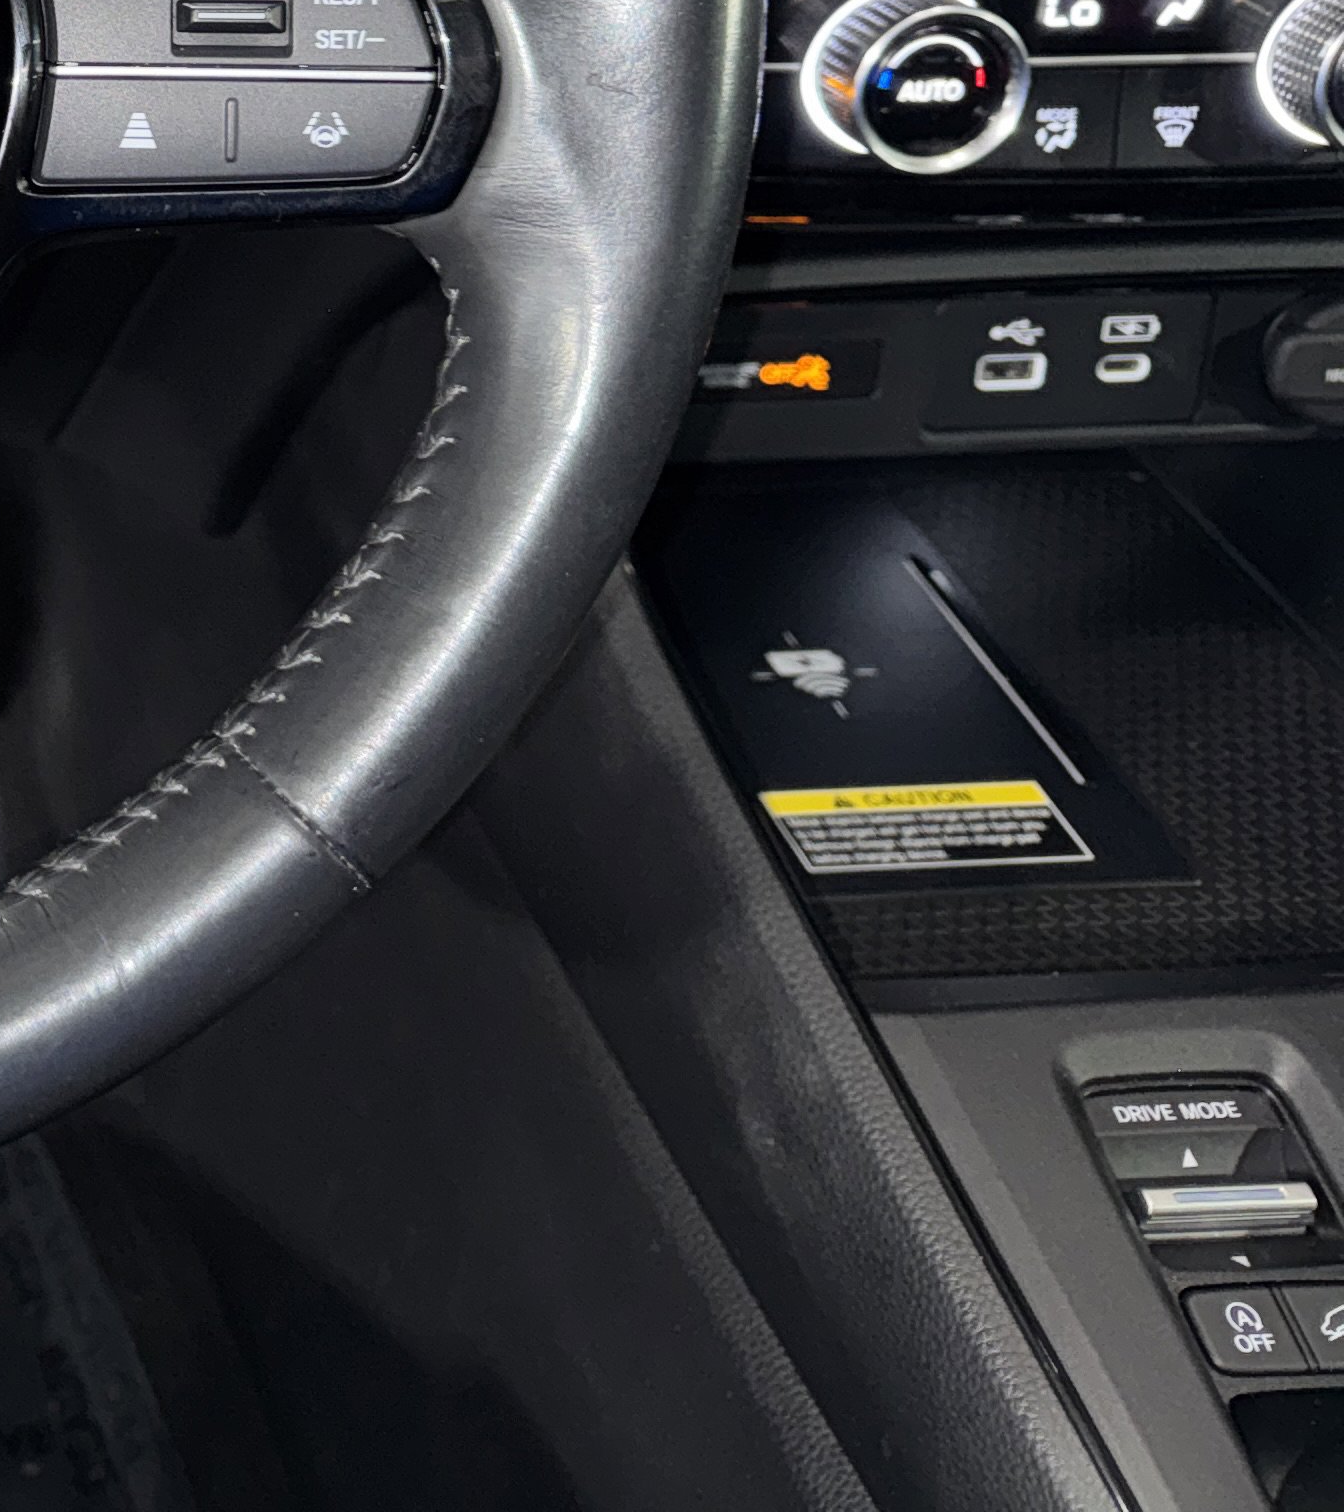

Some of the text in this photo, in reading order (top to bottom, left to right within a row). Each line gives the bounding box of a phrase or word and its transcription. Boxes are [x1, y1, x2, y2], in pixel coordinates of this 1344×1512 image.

[896, 78, 965, 103] AUTO
[1036, 106, 1078, 121] MODE
[1153, 105, 1200, 120] FRONT
[863, 790, 974, 807] CAUTION
[1112, 1100, 1242, 1124] DRIVE MODE
[1234, 1333, 1276, 1353] OFF
